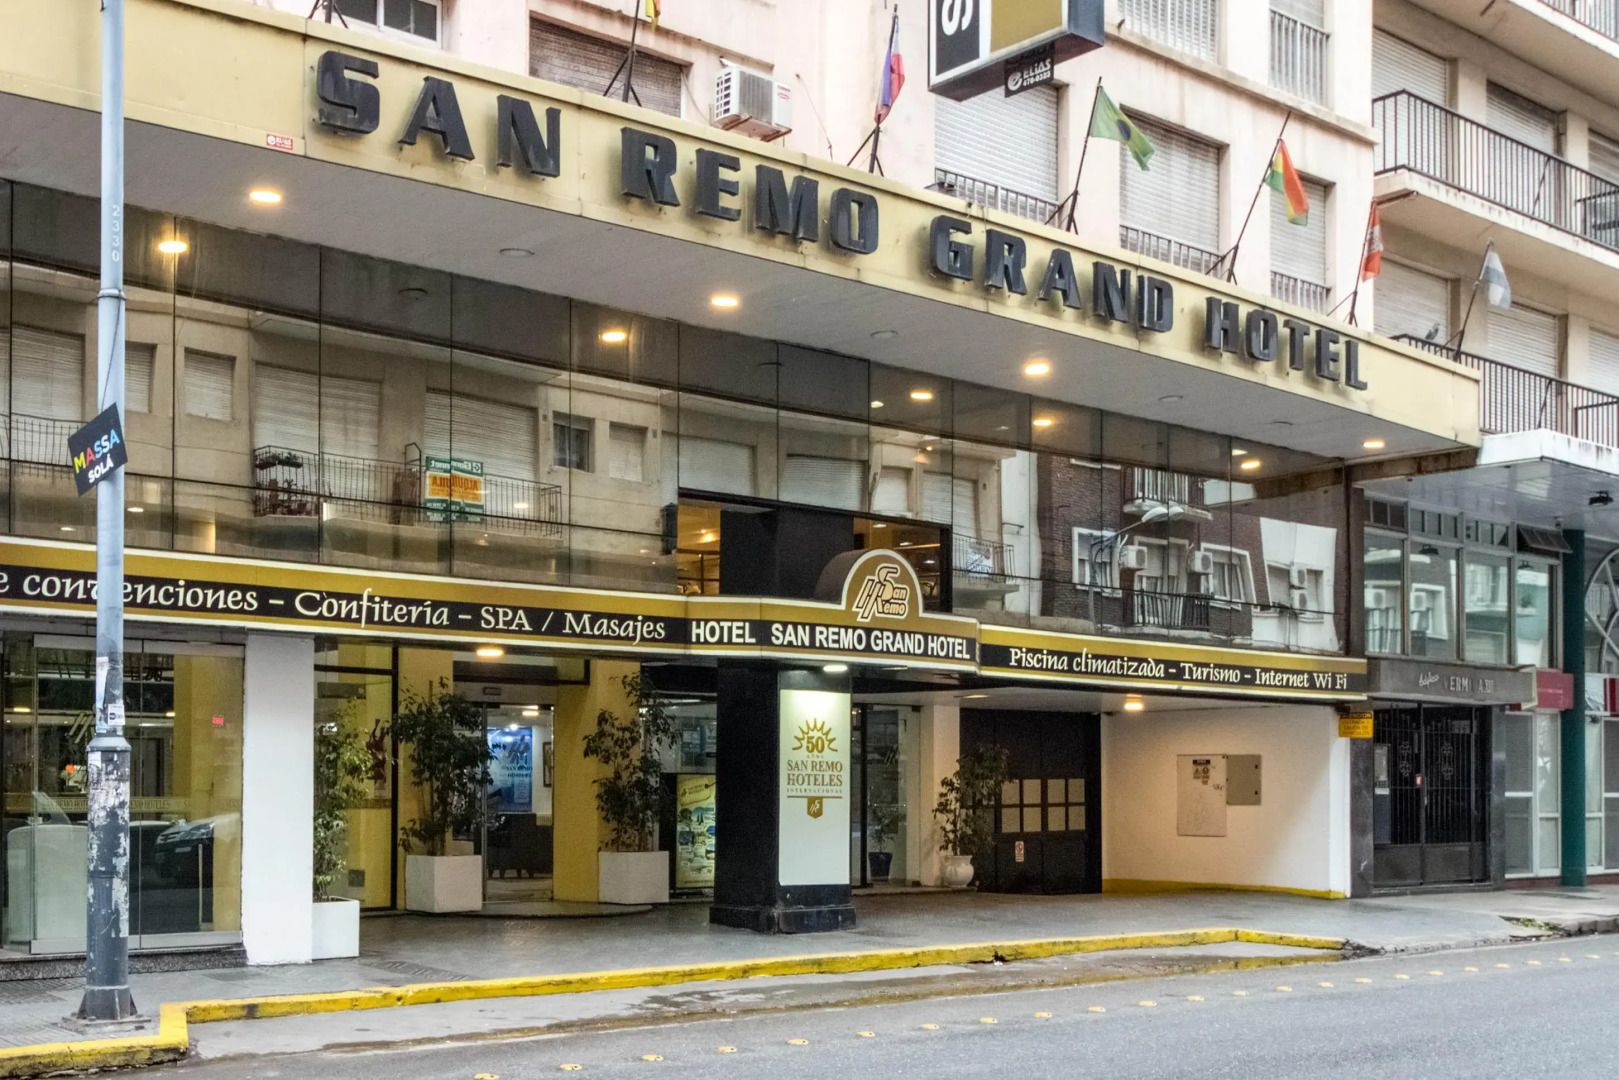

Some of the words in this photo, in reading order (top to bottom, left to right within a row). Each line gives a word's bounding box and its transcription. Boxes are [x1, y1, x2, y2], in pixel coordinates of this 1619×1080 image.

[112, 204, 120, 262] 2330
[317, 50, 561, 178] SAN
[620, 127, 879, 254] REMO
[930, 214, 1173, 332] GRAND
[1205, 297, 1367, 390] HOTEL
[73, 429, 120, 474] MASSA
[88, 453, 114, 483] SOLÁ
[480, 606, 532, 632] SPA
[562, 612, 666, 646] Masajes
[691, 620, 756, 643] HOTEL
[771, 623, 810, 647] SAN
[815, 626, 867, 651] REMO
[870, 630, 925, 656] GRAND
[928, 635, 970, 659] HOTEL
[1009, 648, 1069, 671] Piscina
[1073, 647, 1165, 678] climatizada
[1180, 662, 1241, 683] Turismo
[1254, 668, 1310, 688] Internet
[1313, 672, 1332, 689] Wi
[1335, 673, 1347, 690] Fi
[806, 735, 825, 753] 50
[787, 760, 808, 772] SAN
[811, 760, 843, 773] REMO
[787, 773, 843, 787] HOTELES
